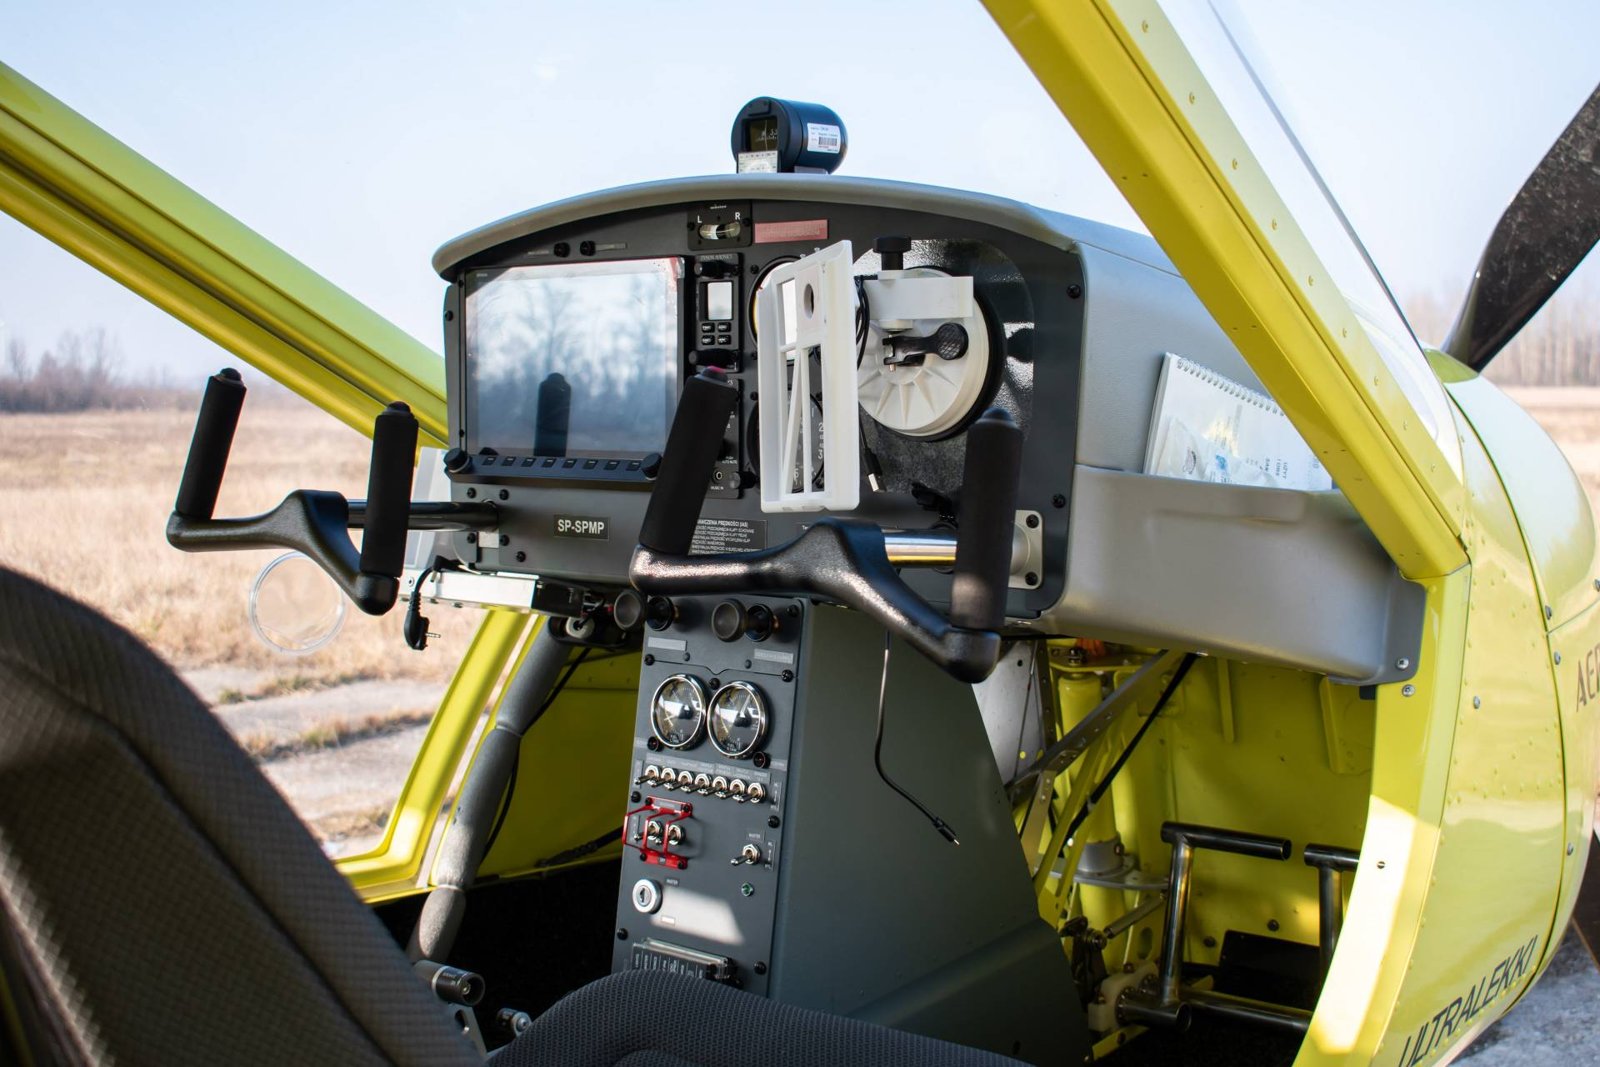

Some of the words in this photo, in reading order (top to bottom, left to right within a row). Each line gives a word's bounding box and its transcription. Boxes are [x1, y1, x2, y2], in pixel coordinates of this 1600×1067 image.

[697, 215, 702, 223] L
[735, 212, 740, 220] R
[557, 519, 605, 535] SP-SPMP
[1398, 934, 1538, 1067] ULTRALEKKI
